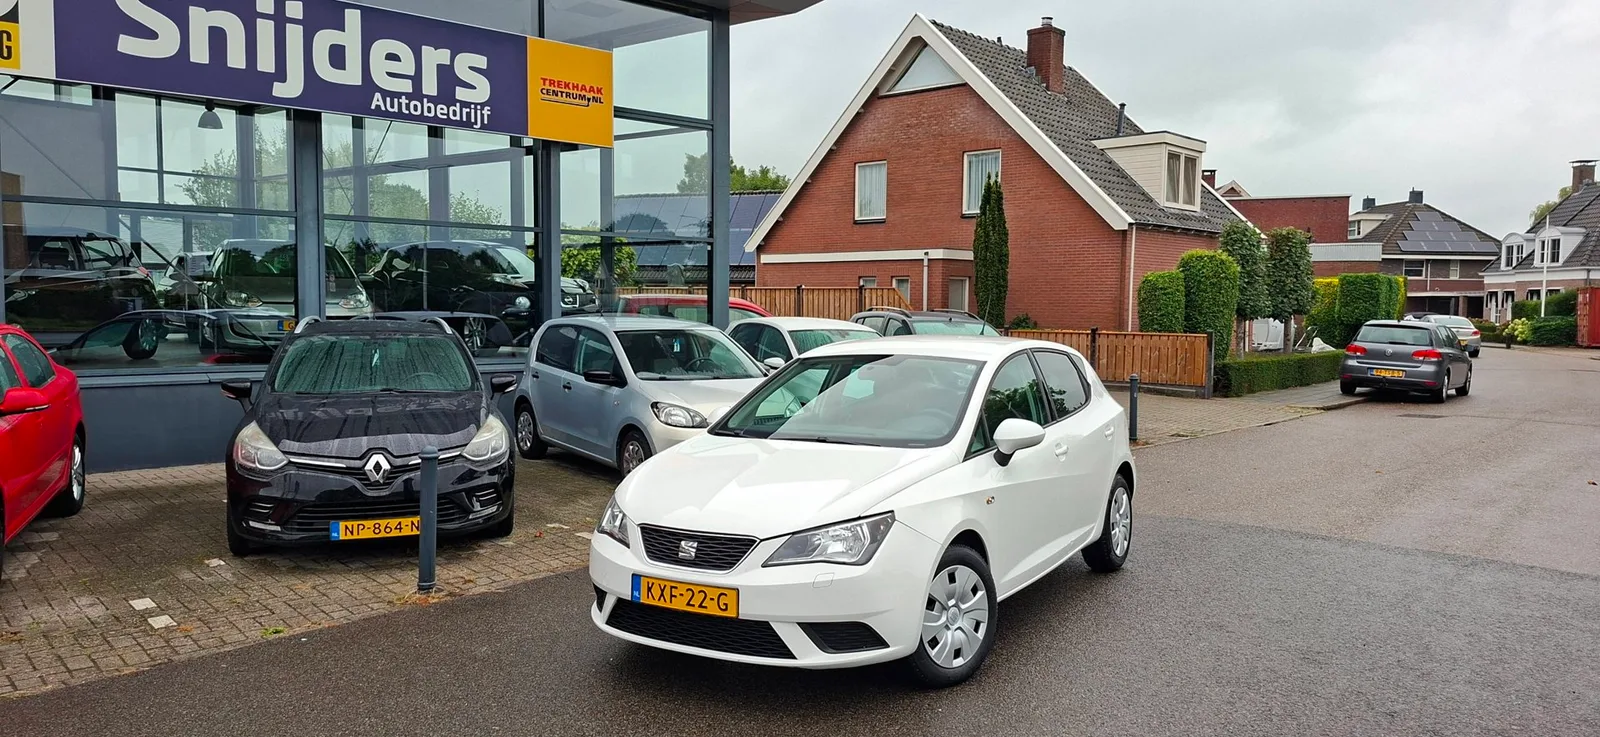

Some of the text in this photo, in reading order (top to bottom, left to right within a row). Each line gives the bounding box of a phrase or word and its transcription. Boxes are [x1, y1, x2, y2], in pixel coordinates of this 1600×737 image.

[118, 0, 491, 102] Snijders
[540, 77, 603, 95] TREKHAAK
[371, 92, 491, 128] Autobedrijf
[646, 581, 729, 612] KXF-22-G
